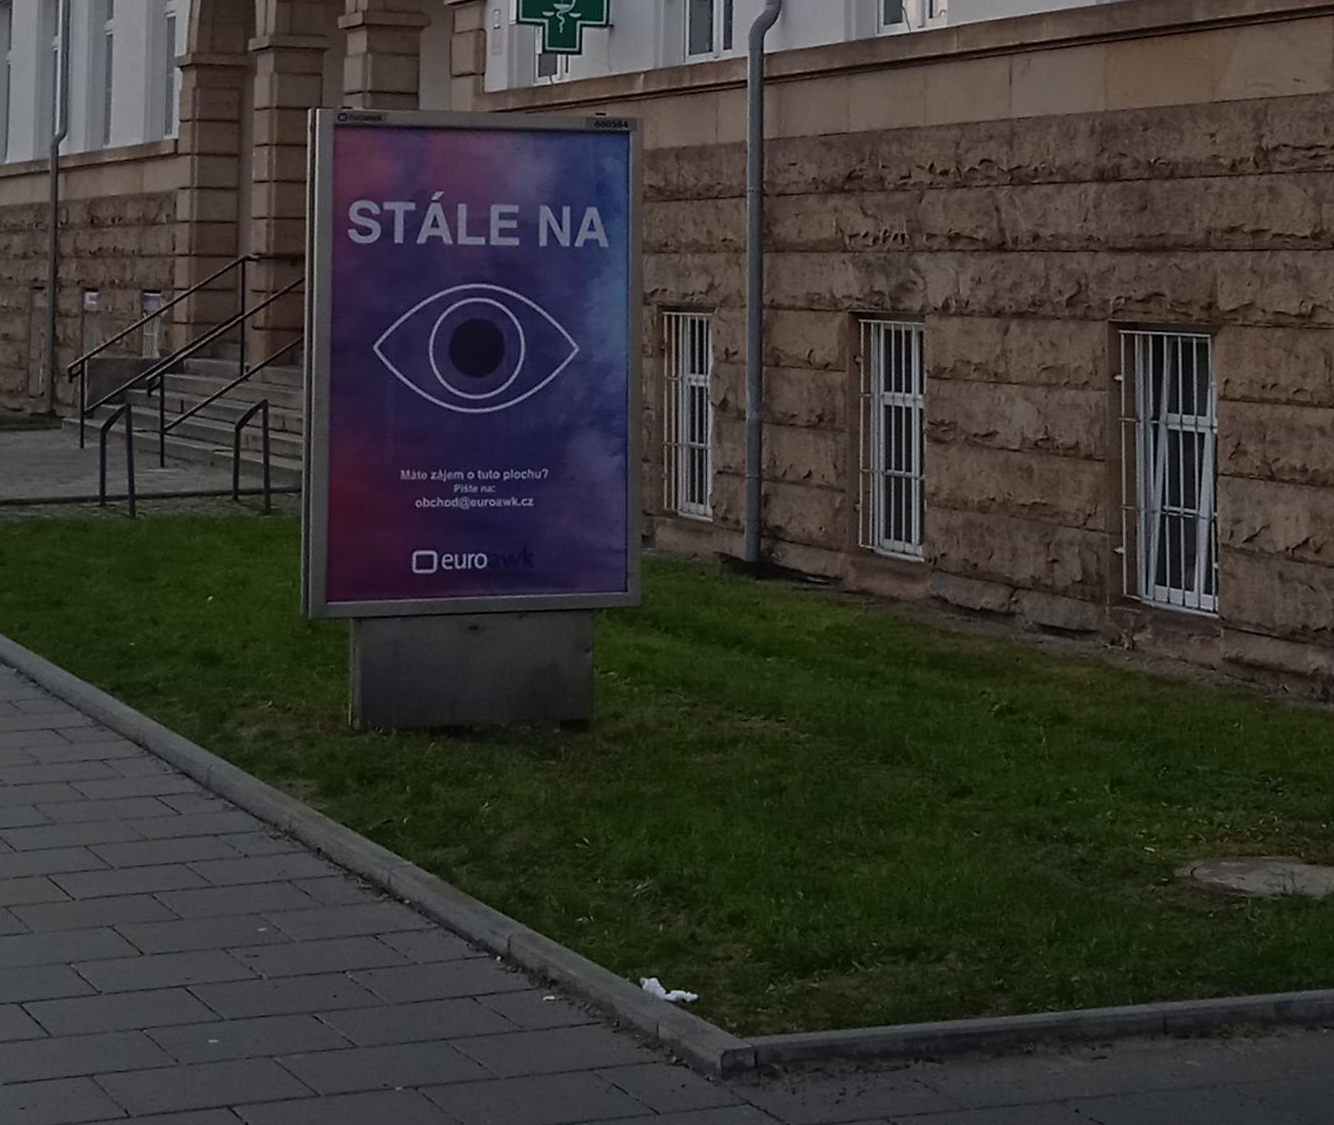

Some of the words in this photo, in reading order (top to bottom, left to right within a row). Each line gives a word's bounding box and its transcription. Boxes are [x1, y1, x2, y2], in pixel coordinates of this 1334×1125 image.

[347, 191, 520, 246] STÁLE
[538, 204, 609, 248] NA
[400, 469, 428, 481] Máte
[430, 469, 464, 482] zájem
[477, 470, 501, 479] tuto
[502, 468, 549, 481] plochu?
[480, 483, 496, 493] na:
[415, 496, 534, 510] obchod@euroawk.cz
